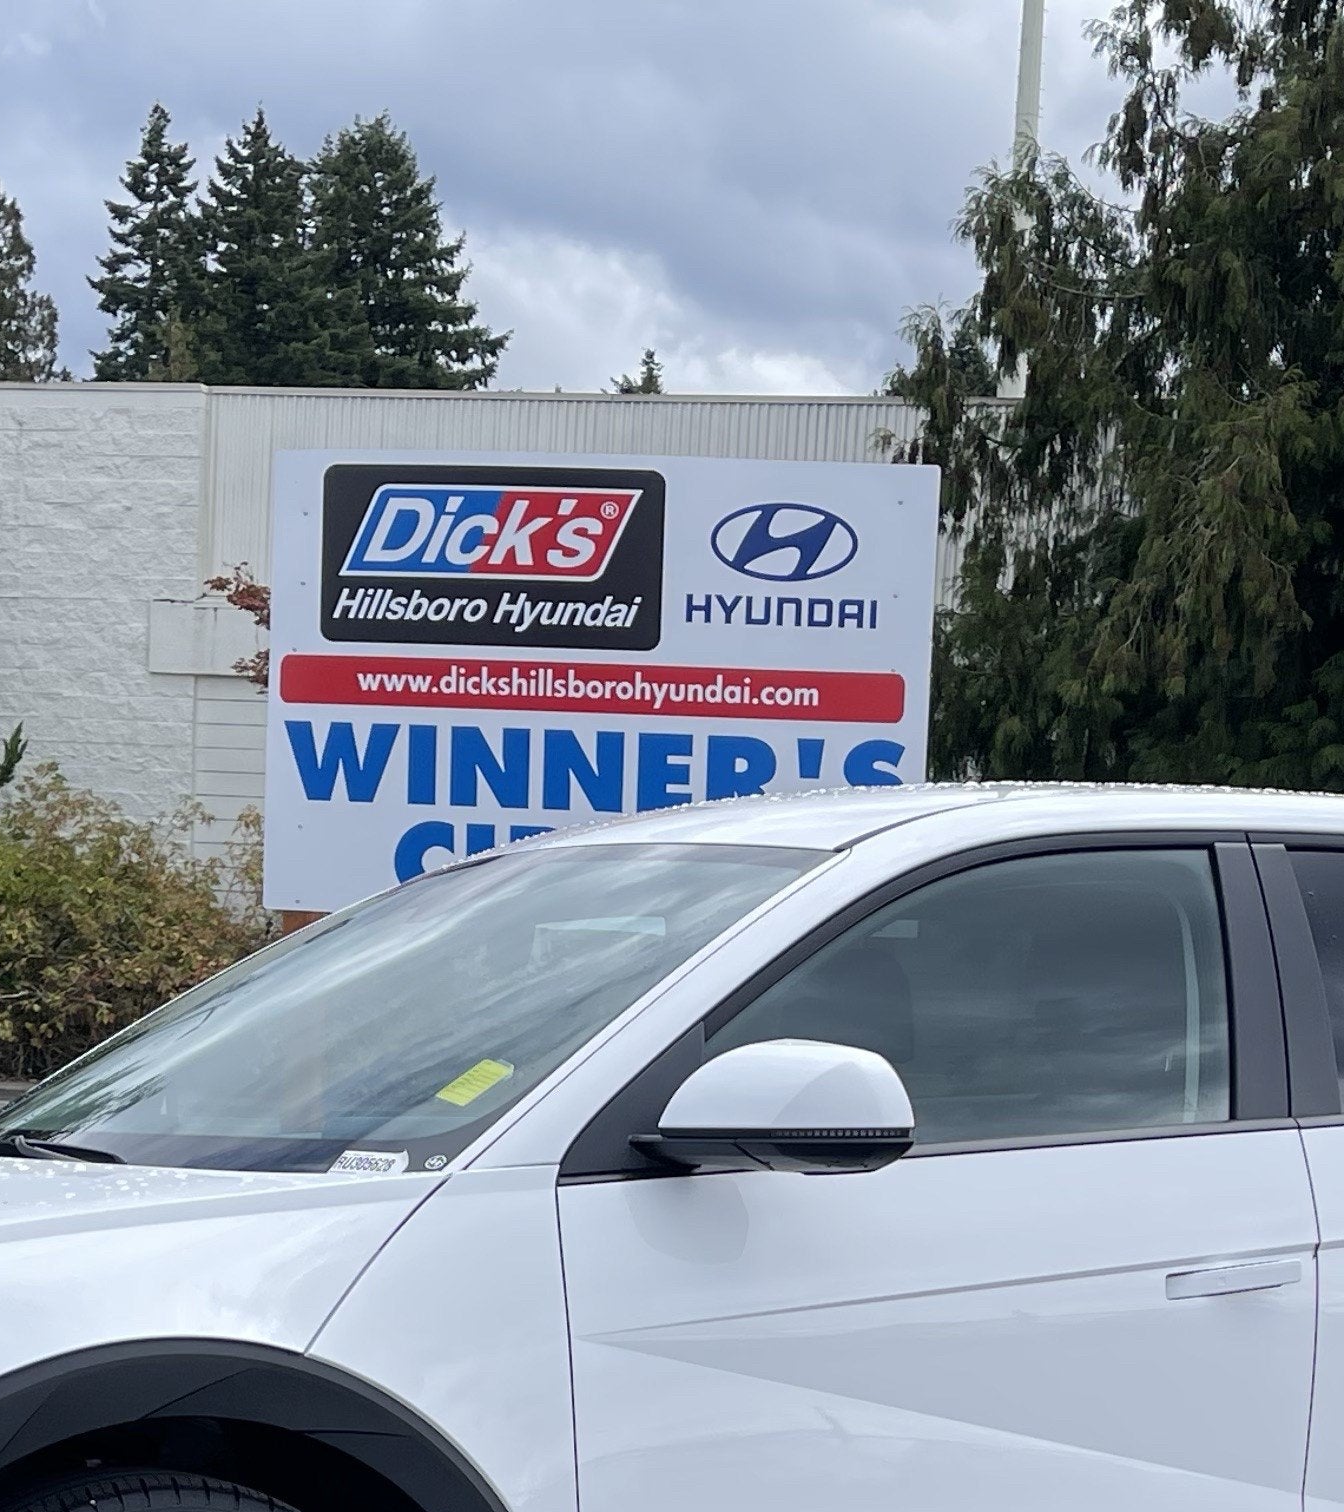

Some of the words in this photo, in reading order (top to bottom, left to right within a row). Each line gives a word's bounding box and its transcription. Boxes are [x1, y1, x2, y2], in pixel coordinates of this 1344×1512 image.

[362, 496, 603, 568] Dick's
[332, 588, 488, 622] Hillsboro
[493, 592, 642, 632] Hyundai
[686, 594, 877, 629] HYUNDAI
[356, 666, 819, 709] www.dickshillsborohyundai.com
[284, 720, 906, 813] WINNER'S
